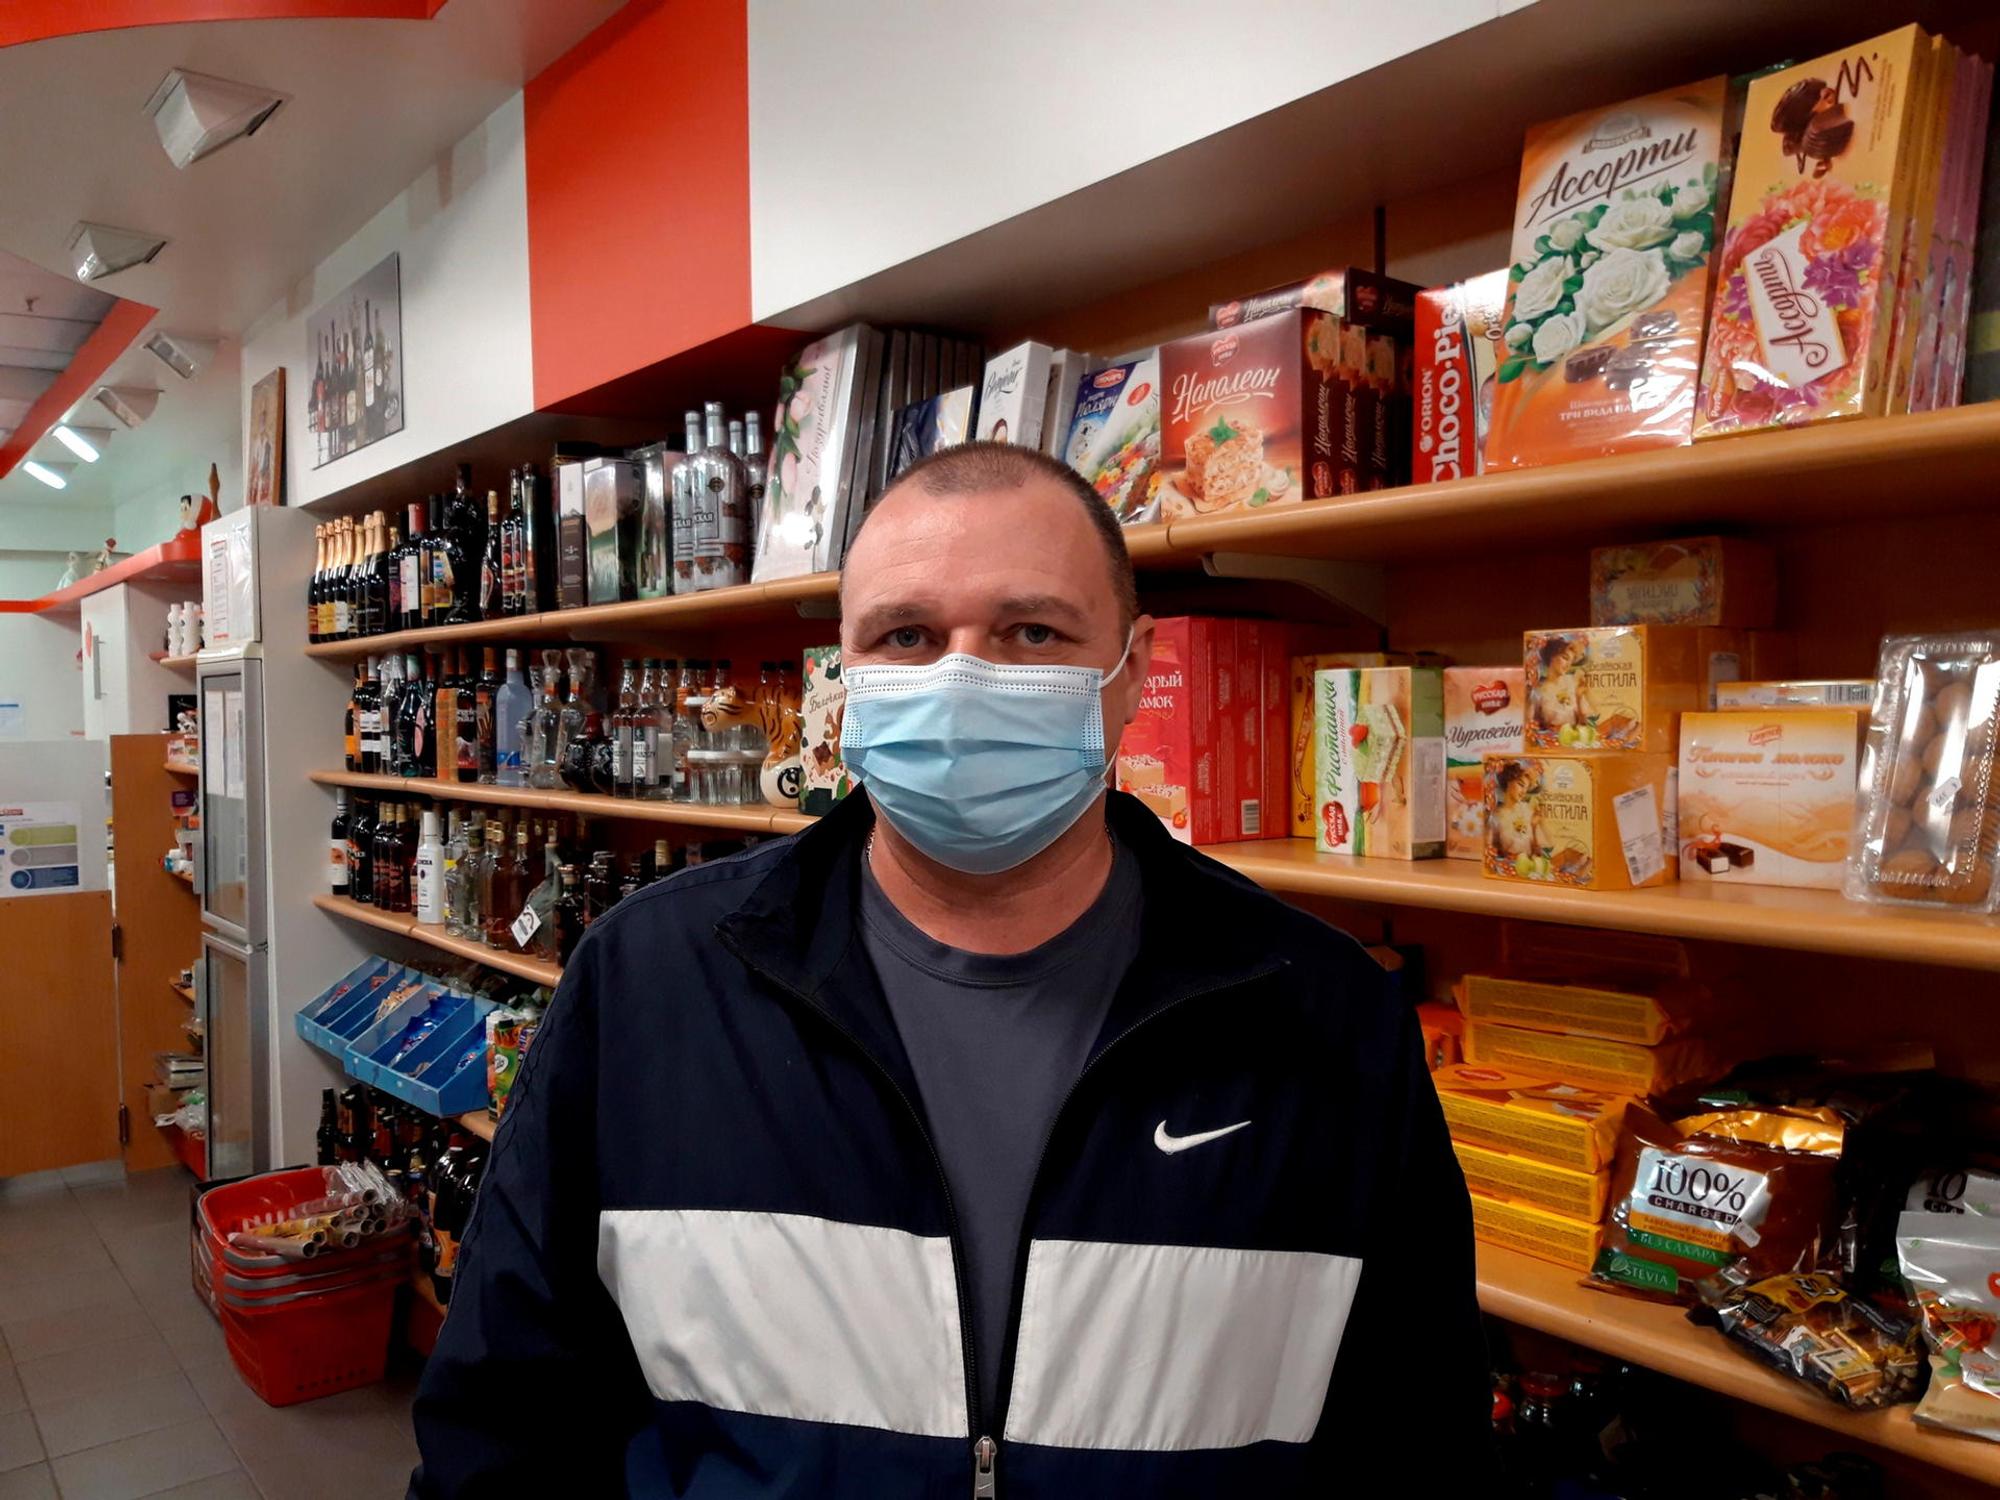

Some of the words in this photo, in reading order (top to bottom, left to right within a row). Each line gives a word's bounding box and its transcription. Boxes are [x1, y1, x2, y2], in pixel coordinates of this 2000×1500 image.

[1524, 127, 1697, 229] Ассорти
[1753, 248, 1829, 368] Ассорти
[1172, 367, 1281, 425] Наполеон
[1420, 369, 1434, 431] ORION
[1143, 670, 1183, 693] арый
[1584, 672, 1638, 689] ПАСТИЛА
[1139, 694, 1174, 709] амок
[1322, 678, 1343, 798] Фисташки
[1445, 720, 1523, 749] Муравейни
[1539, 802, 1588, 822] ПАСТИЛА
[1651, 1158, 1746, 1212] 100%
[1654, 1196, 1735, 1225] CHARGED
[1625, 1266, 1669, 1287] STEVIA
